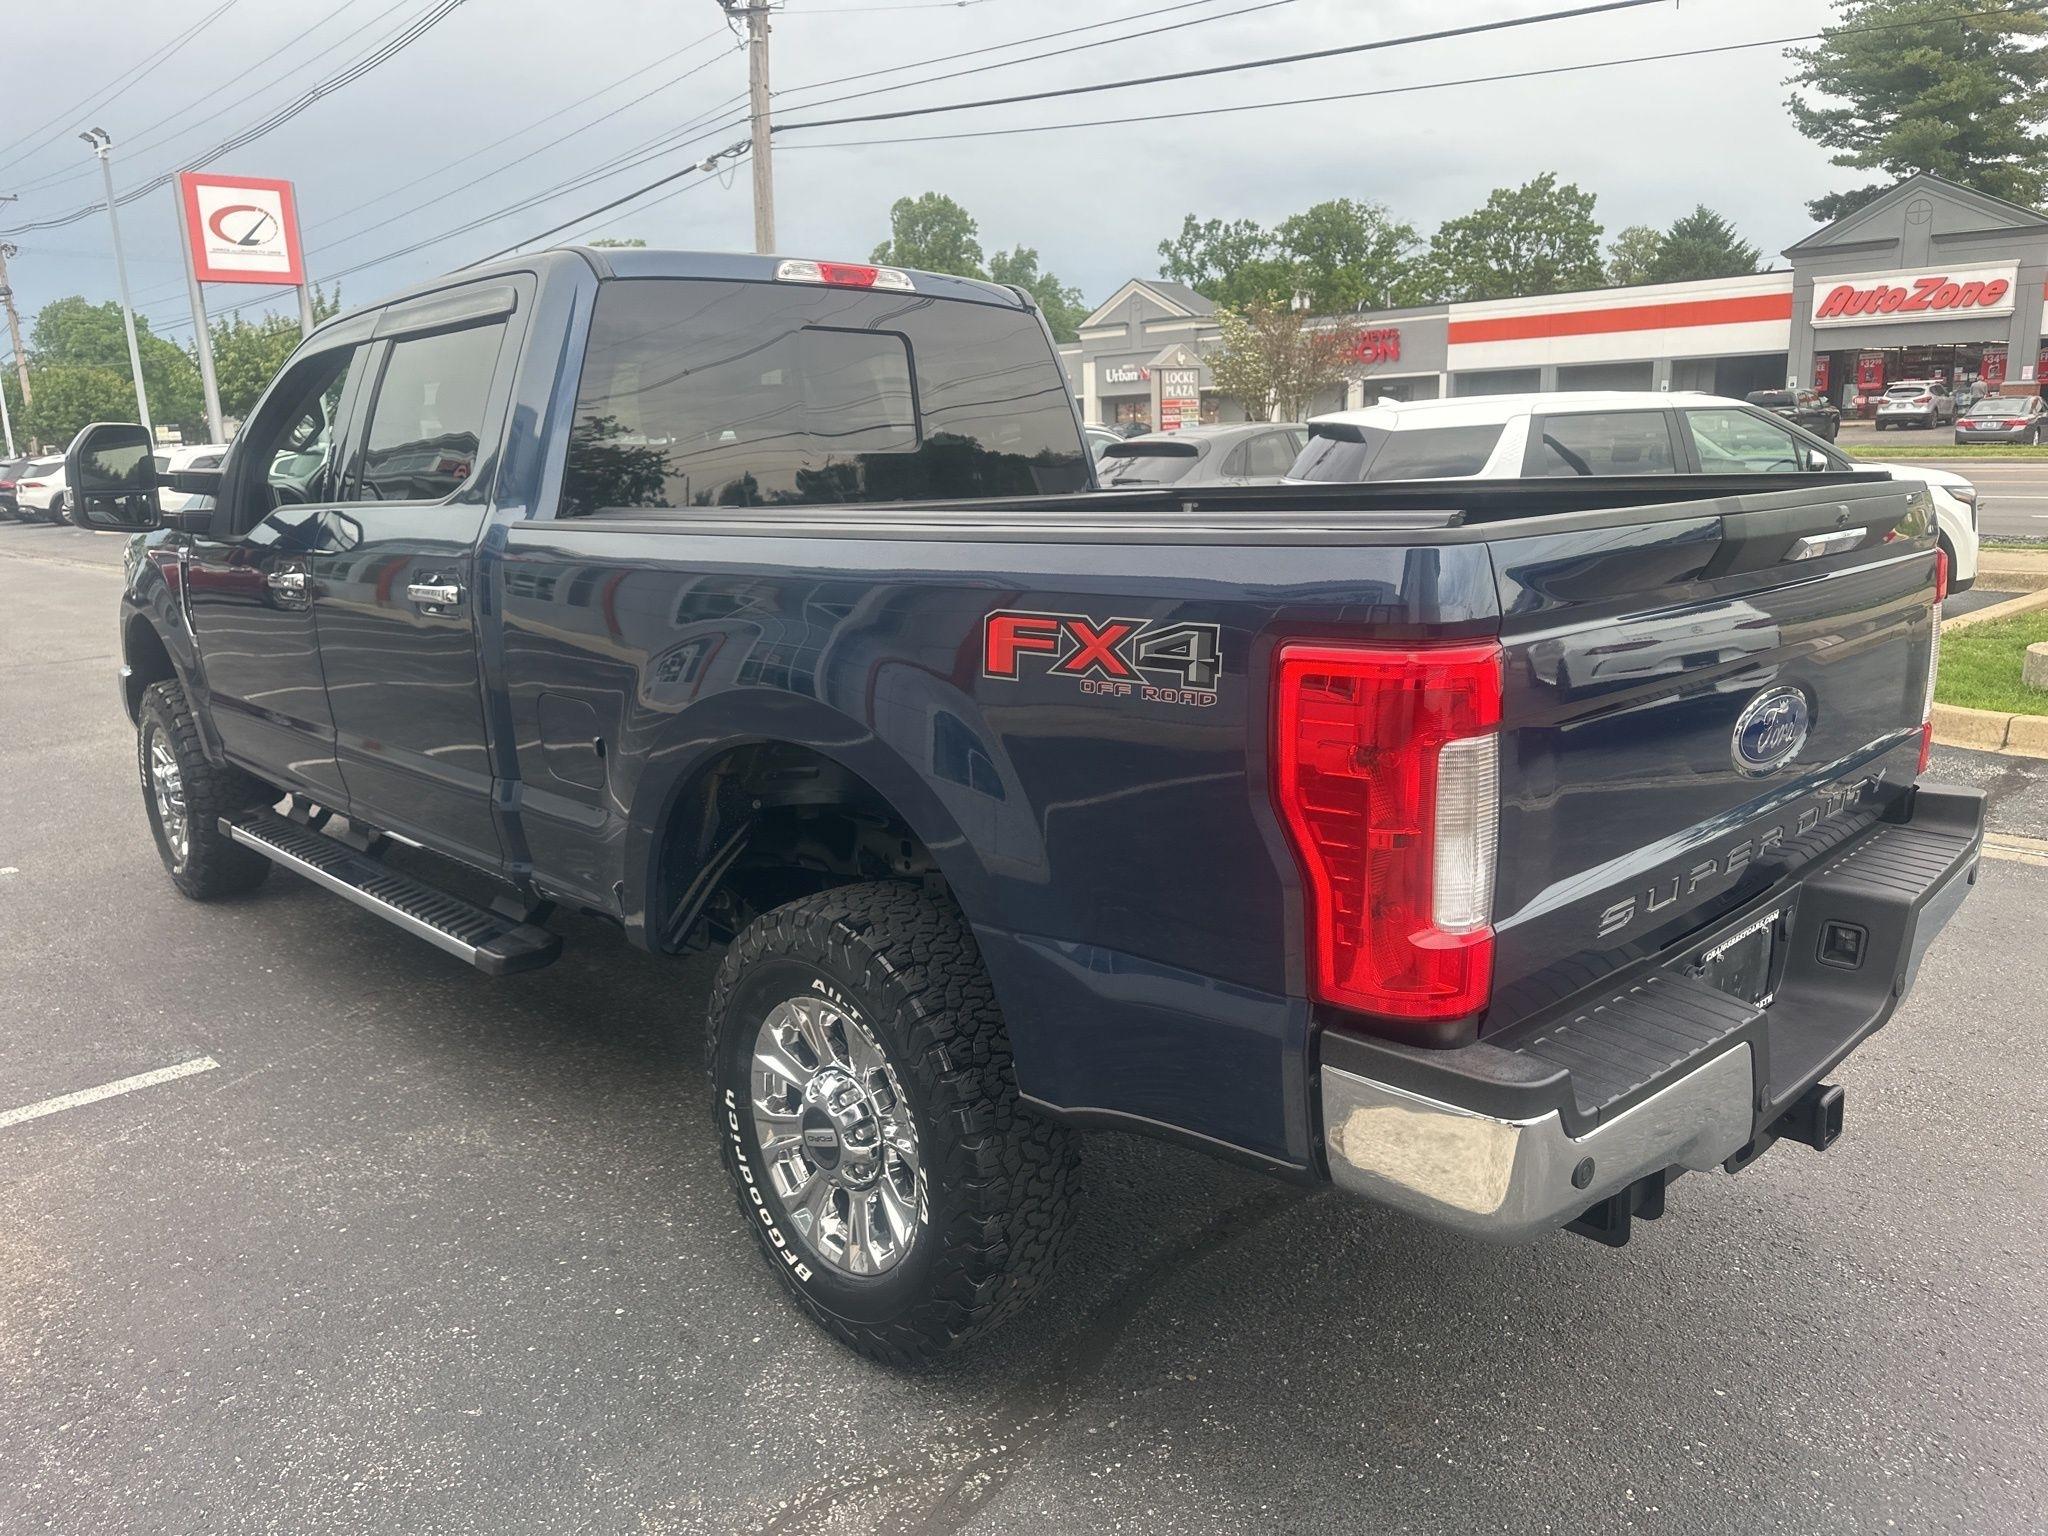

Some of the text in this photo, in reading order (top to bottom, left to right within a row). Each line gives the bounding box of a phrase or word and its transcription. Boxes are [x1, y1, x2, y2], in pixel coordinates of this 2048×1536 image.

[1815, 276, 2009, 318] AutoZone
[1105, 368, 1139, 383] Urban
[1165, 371, 1194, 384] LOCKE
[1165, 385, 1194, 397] PLAZA
[983, 608, 1222, 692] FX4
[1079, 678, 1218, 707] OFF ROAD
[1757, 698, 1799, 754] Ford
[1597, 767, 1888, 939] SUPER DUTY
[724, 1088, 813, 1282] BFGoodrich
